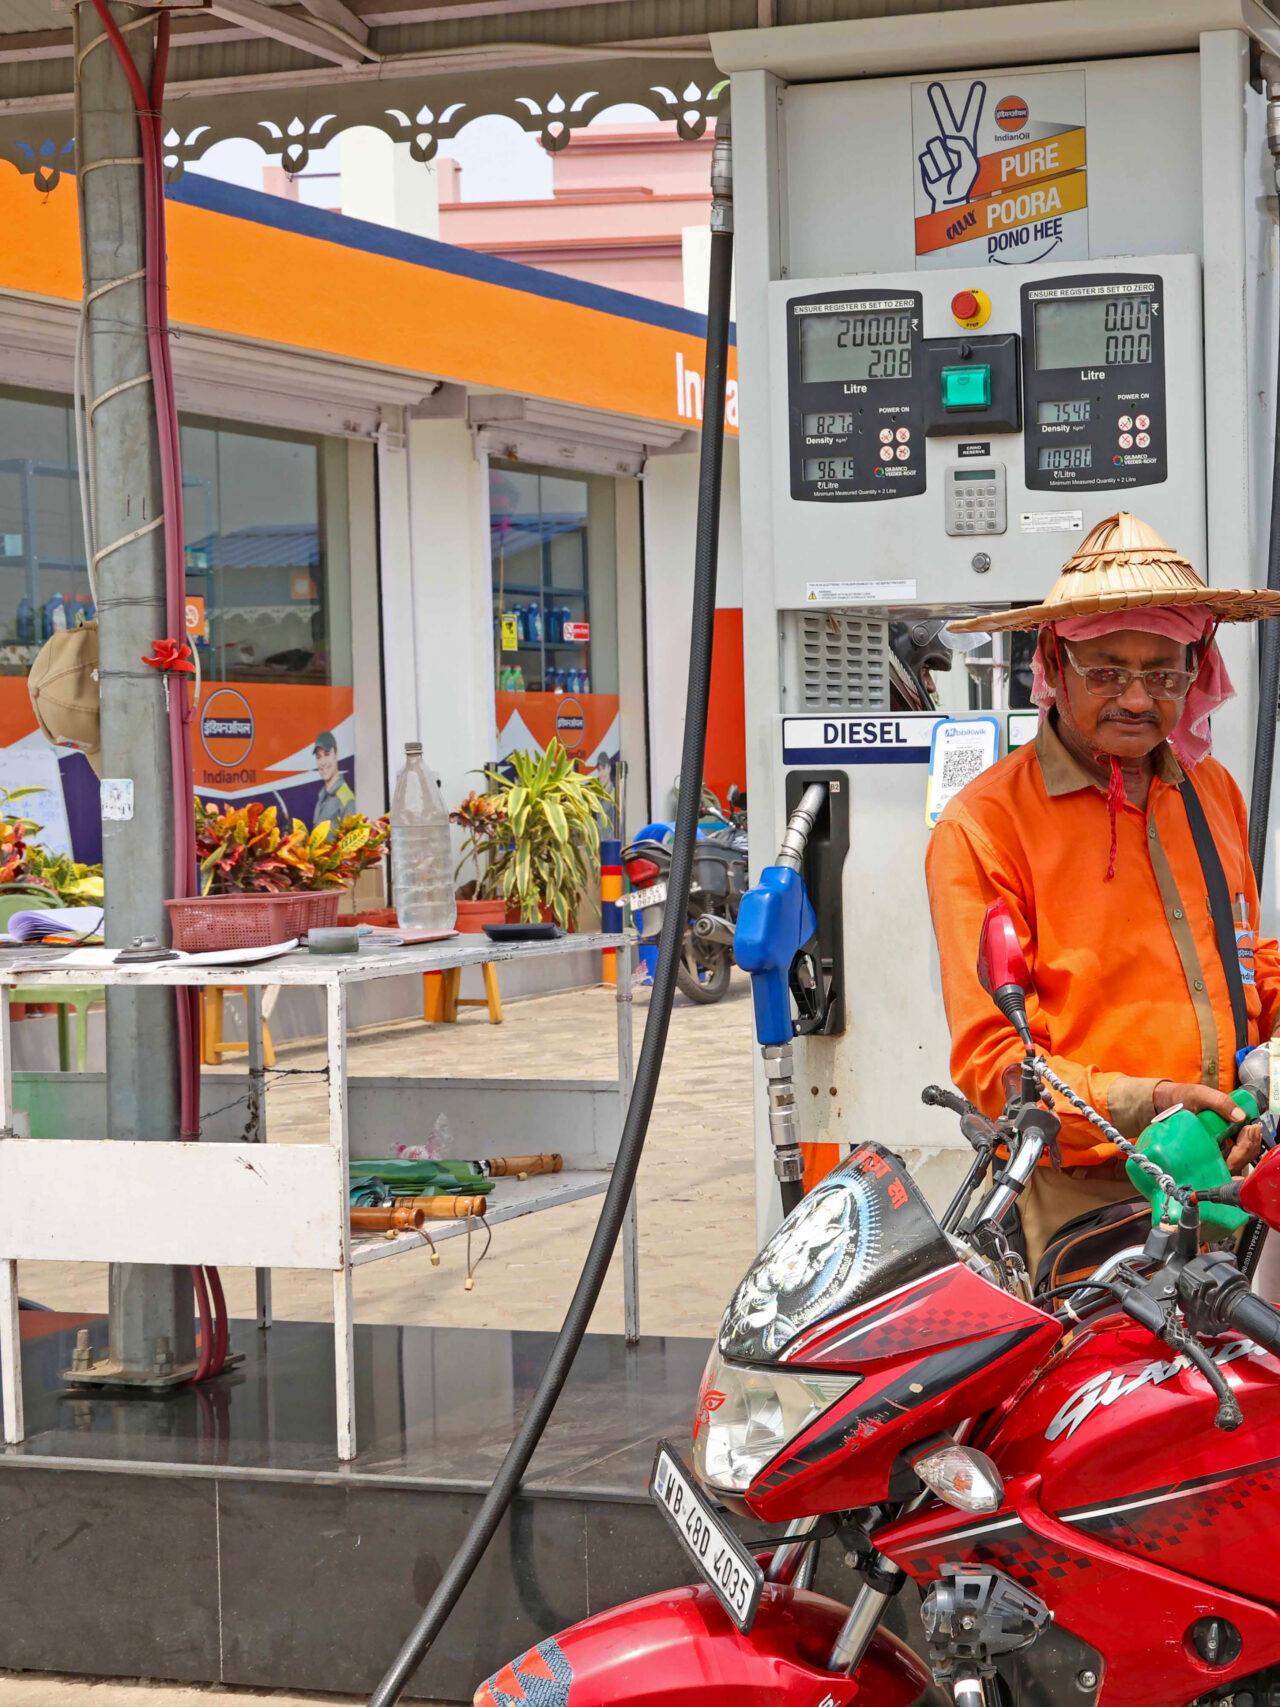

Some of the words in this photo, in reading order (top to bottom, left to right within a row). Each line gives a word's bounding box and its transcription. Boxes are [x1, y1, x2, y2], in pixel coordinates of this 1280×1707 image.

[994, 132, 1030, 142] IndianOil
[1001, 143, 1059, 182] PURE
[987, 187, 1062, 229] POORA
[987, 227, 1030, 254] DONO
[1034, 217, 1063, 241] HEE
[1029, 290, 1058, 299] ENSURE
[1060, 288, 1096, 297] REGISTER
[1133, 284, 1154, 292] ZERO
[794, 305, 822, 314] ENSURE
[824, 303, 859, 312] REGISTER
[868, 301, 882, 309] SET
[882, 300, 893, 308] TO
[894, 299, 914, 308] ZERO
[1104, 301, 1150, 332] 0.00
[837, 316, 910, 348] 200.00
[1105, 334, 1151, 365] 0.00
[868, 348, 911, 378] 2.08
[1081, 370, 1105, 381] Litre
[843, 384, 868, 394] Litre
[1041, 425, 1071, 433] Density
[806, 437, 833, 445] Density
[823, 722, 907, 744] DIESEL
[203, 769, 256, 784] IndianOil
[1248, 1234, 1259, 1251] TYPE
[664, 1472, 684, 1515] WB
[685, 1506, 711, 1558] 48D
[713, 1548, 750, 1611] 4035
